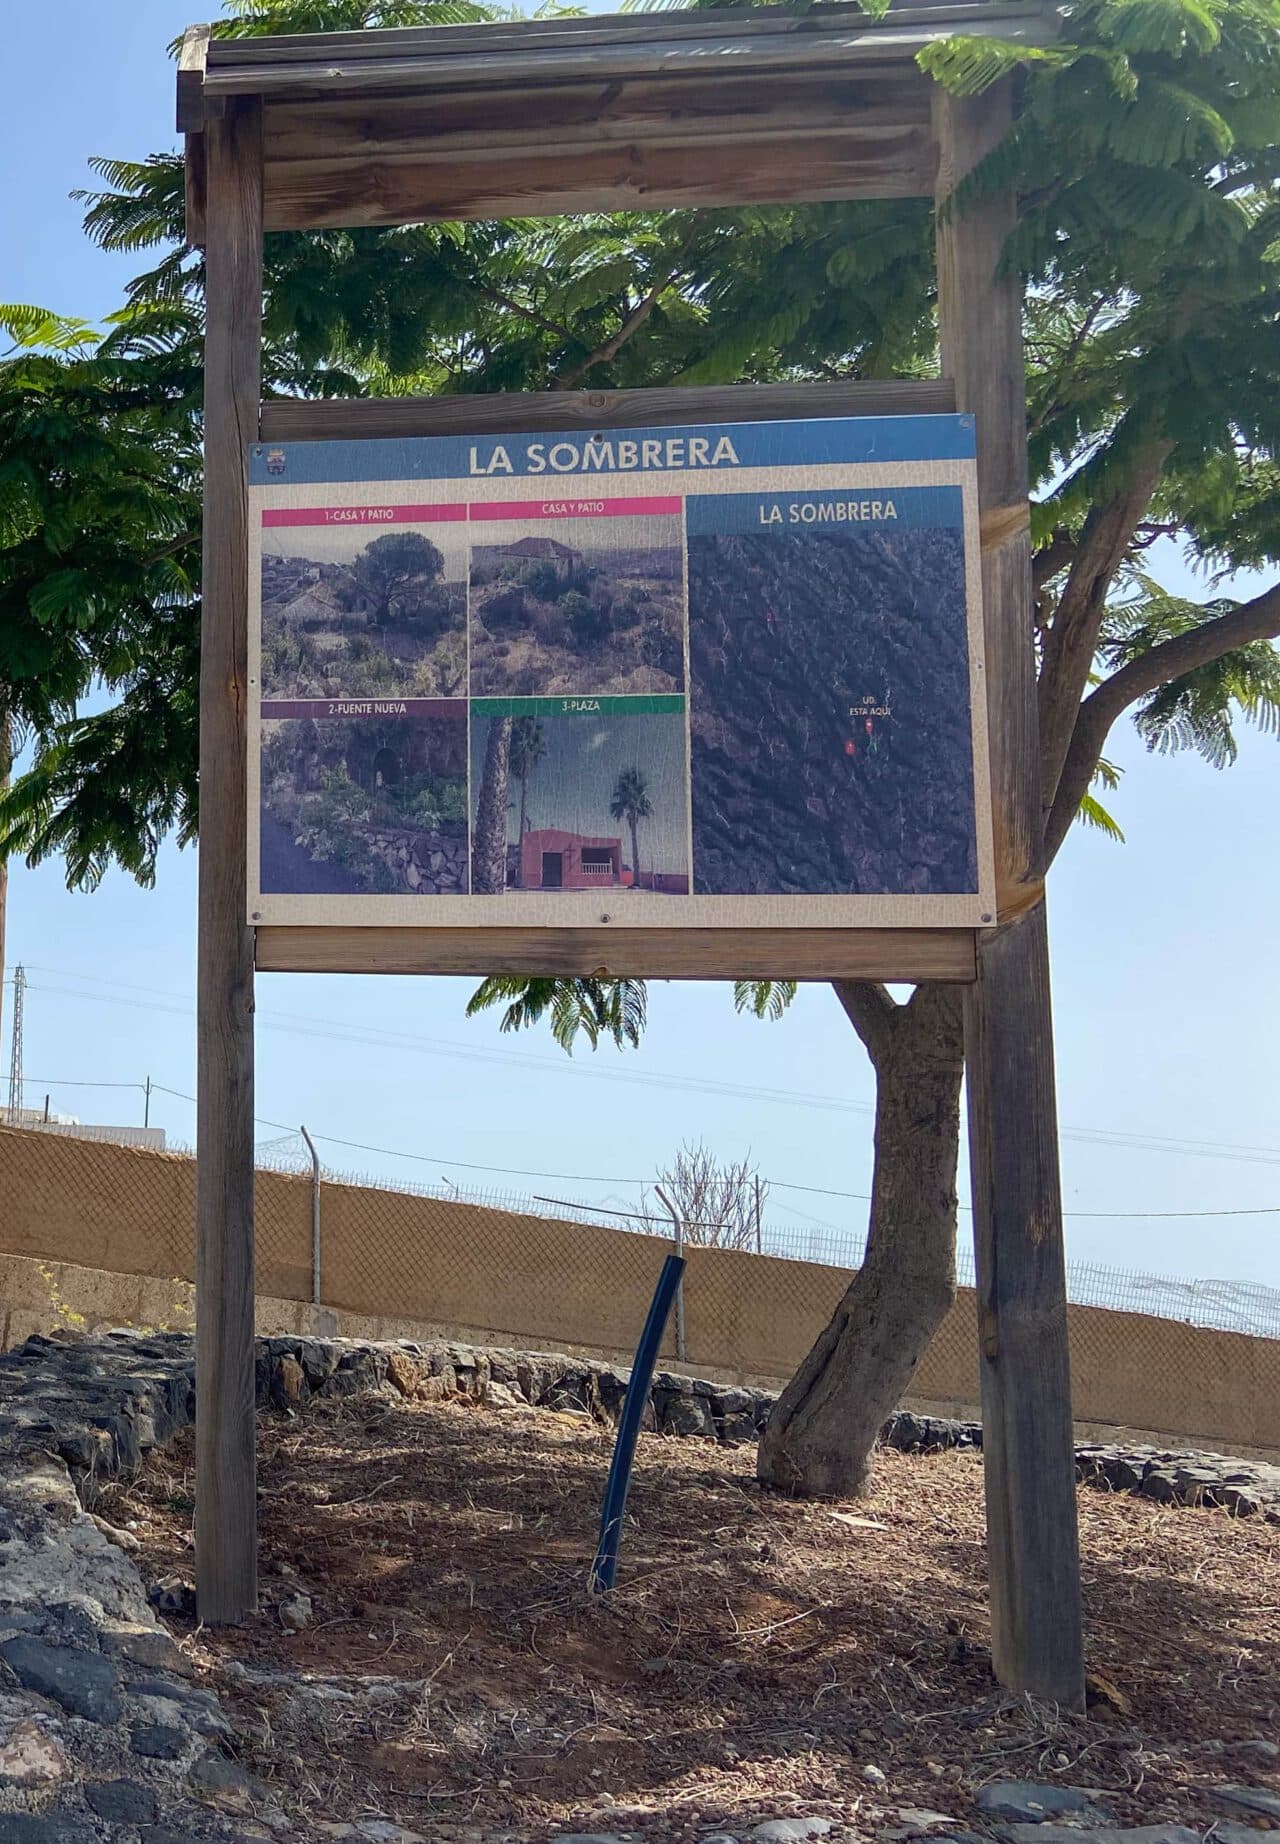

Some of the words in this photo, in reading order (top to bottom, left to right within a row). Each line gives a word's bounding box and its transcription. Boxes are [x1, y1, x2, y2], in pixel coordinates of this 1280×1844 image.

[470, 446, 513, 474] LA
[527, 436, 740, 473] SOMBRERA
[542, 503, 567, 514] CASA
[569, 503, 575, 513] Y
[577, 502, 605, 513] PATIO
[760, 504, 783, 524] LA
[789, 501, 898, 523] SOMBRERA
[325, 510, 358, 521] 1-CASA
[360, 510, 366, 519] Y
[368, 509, 394, 519] PATIO
[329, 703, 373, 714] 2-FUENTE
[375, 703, 407, 713] NUEVA
[562, 700, 600, 711] 3-PLAZA
